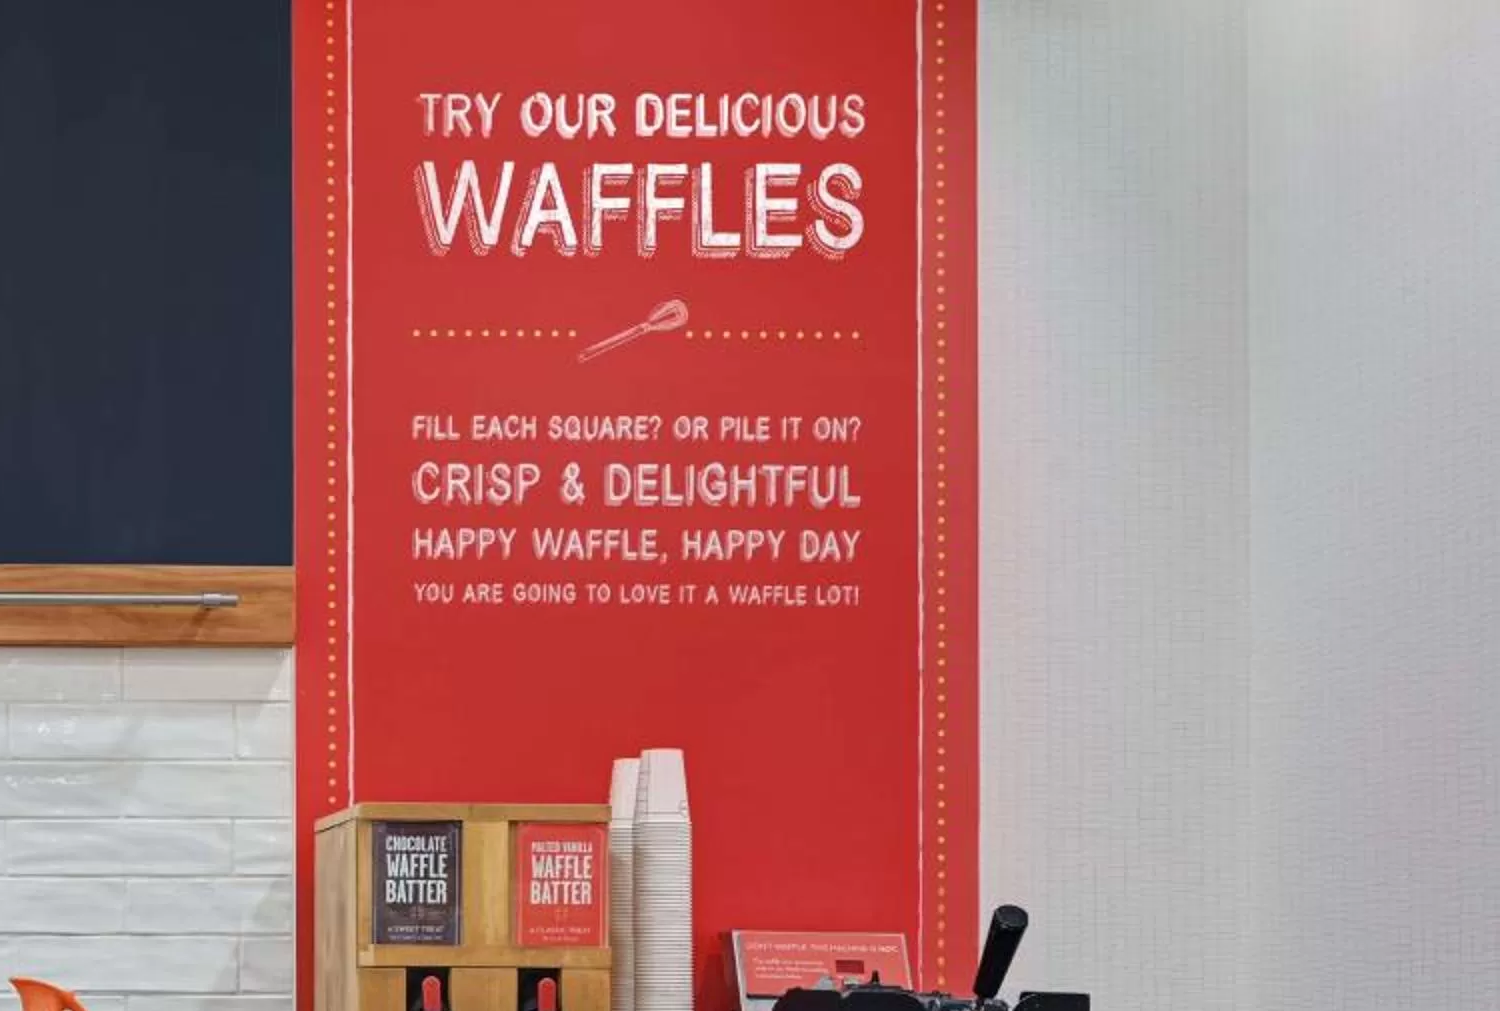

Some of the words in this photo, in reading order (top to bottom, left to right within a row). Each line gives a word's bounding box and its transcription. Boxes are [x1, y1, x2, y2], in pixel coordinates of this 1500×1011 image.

[417, 92, 502, 138] TRY
[520, 92, 617, 139] OUR
[635, 92, 867, 139] DELICIOUS
[413, 160, 866, 260] WAFFLES
[412, 415, 460, 441] FILL
[472, 415, 537, 441] EACH
[548, 415, 661, 442] SQUARE?
[673, 415, 709, 442] OR
[719, 416, 770, 442] PILE
[780, 416, 803, 441] IT
[812, 416, 861, 442] ON?
[412, 462, 541, 507] CRISP
[560, 462, 586, 506] &
[604, 462, 861, 508] DELIGHTFUL
[412, 527, 516, 561] HAPPY
[532, 527, 668, 565] WAFFLE,
[681, 529, 786, 562] HAPPY
[799, 529, 861, 562] DAY
[414, 583, 454, 604] YOU
[462, 583, 503, 604] ARE
[513, 583, 577, 604] GOING
[586, 583, 611, 605] TO
[619, 584, 671, 605] LOVE
[679, 584, 696, 605] IT
[704, 585, 719, 606] A
[729, 585, 807, 606] WAFFLE
[816, 585, 860, 607] LOT!
[385, 835, 447, 852] CHOCOLATE
[386, 853, 448, 878] WAFFLE
[531, 855, 592, 879] WAFFLE
[385, 879, 447, 904] BATTER
[530, 880, 592, 905] BATTER
